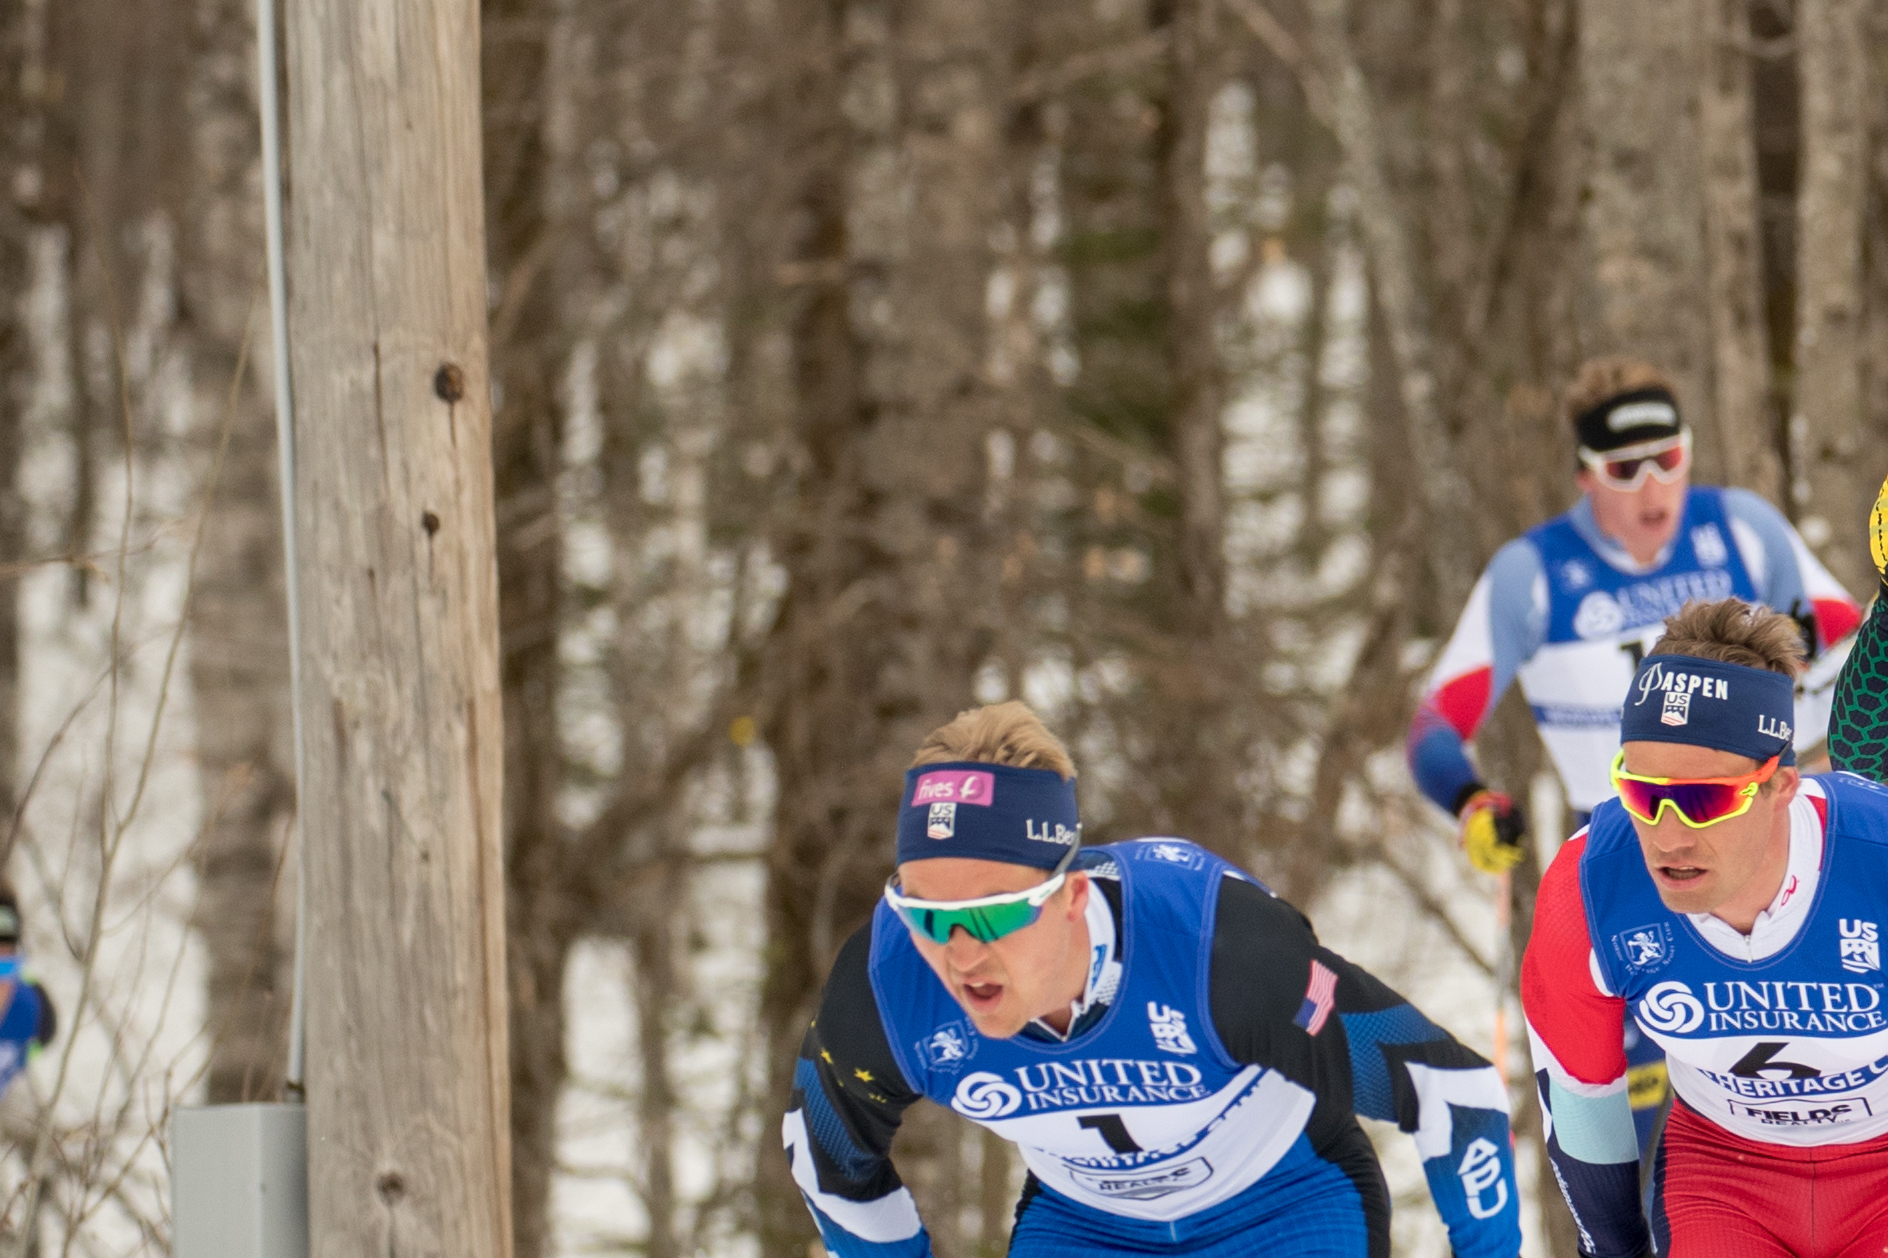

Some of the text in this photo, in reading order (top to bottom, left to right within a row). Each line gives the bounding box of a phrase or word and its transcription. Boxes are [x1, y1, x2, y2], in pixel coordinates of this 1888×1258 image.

[1661, 671, 1728, 700] ASPEN
[1667, 693, 1689, 705] US
[918, 777, 955, 800] fives
[931, 803, 954, 816] US
[1838, 918, 1879, 942] US
[1703, 981, 1881, 1013] UNITED
[1709, 1010, 1887, 1033] INSURANCE
[1013, 1058, 1203, 1093] UNITED
[1727, 1042, 1822, 1080] 6
[1028, 1082, 1213, 1111] INSURANCE
[1720, 1070, 1866, 1098] HERITAGE
[1076, 1113, 1145, 1155] 1
[1457, 1137, 1509, 1220] APU
